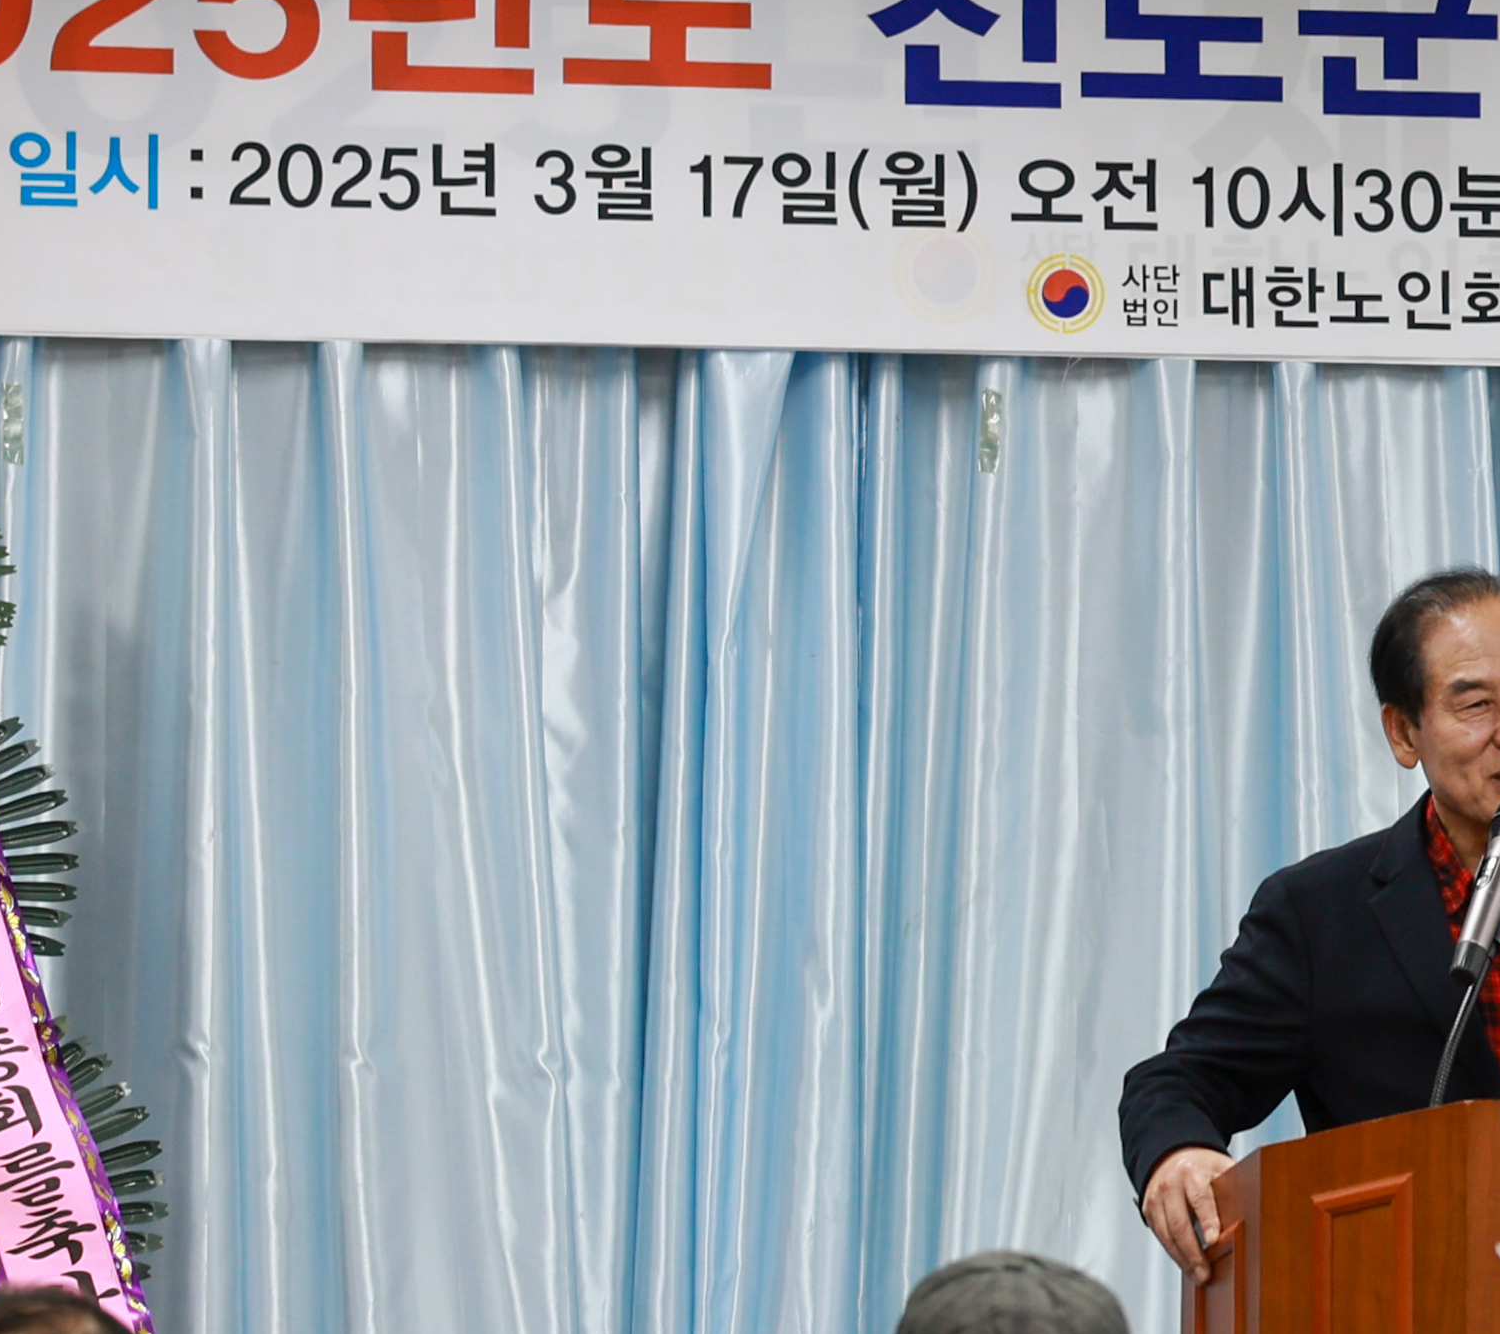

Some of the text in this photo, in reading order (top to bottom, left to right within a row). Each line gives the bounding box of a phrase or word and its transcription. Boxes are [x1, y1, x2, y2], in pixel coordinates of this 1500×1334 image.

[9, 130, 161, 211] 일시
[229, 141, 498, 217] 2025년
[534, 144, 654, 222] 3월
[689, 148, 979, 233] 17일(월)
[1011, 158, 1159, 232] 오전
[1122, 264, 1180, 293] 사단
[1123, 297, 1180, 327] 법인
